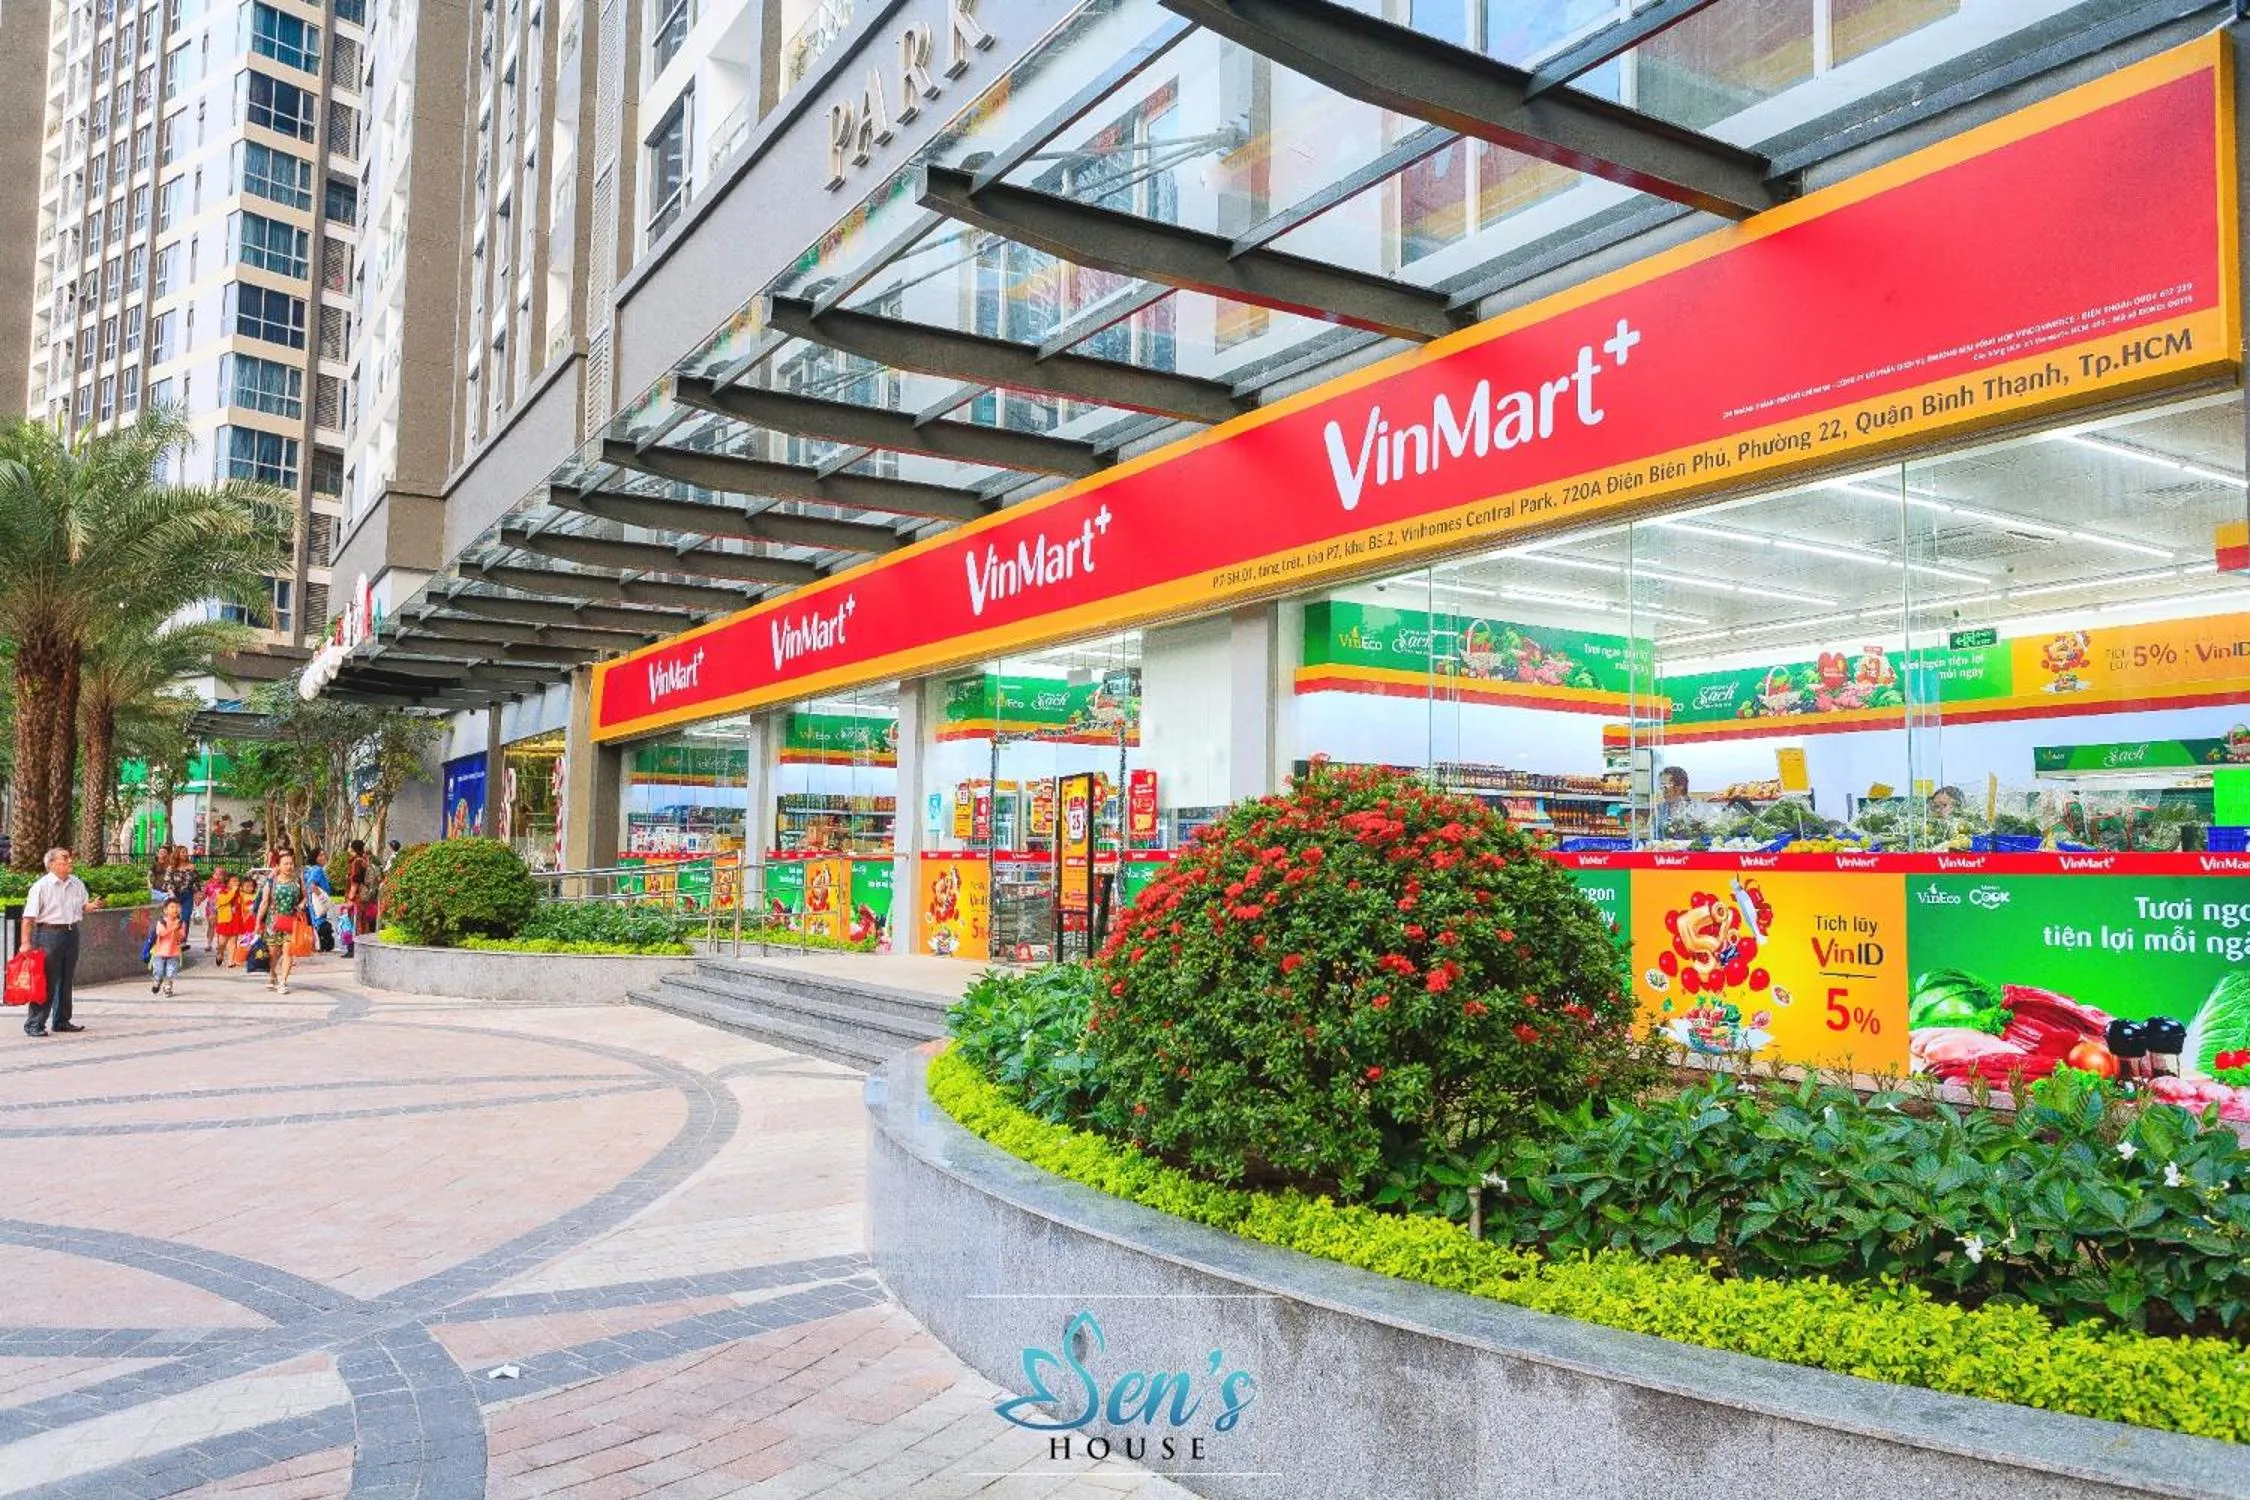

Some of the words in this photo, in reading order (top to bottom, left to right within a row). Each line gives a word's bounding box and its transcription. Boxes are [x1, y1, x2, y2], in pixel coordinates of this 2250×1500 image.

[823, 0, 996, 192] PARK
[1401, 517, 1462, 543] Vinhomes
[1466, 504, 1516, 527] Central
[1562, 480, 1602, 505] 720A
[1738, 432, 1812, 461] Phường
[1819, 418, 1848, 442] 22,
[1856, 404, 1914, 434] Quận
[1921, 384, 1974, 417] Bình
[1983, 363, 2070, 398] Thạnh,
[2078, 328, 2192, 378] Tp.HCM
[2134, 896, 2193, 920] Tươi
[1814, 914, 1847, 931] Tích
[1853, 915, 1878, 938] lũy
[2043, 924, 2092, 951] tiện
[2101, 925, 2134, 953] lợi
[2144, 925, 2196, 953] mỗi
[1811, 936, 1884, 968] VinID
[1825, 987, 1881, 1035] 5%
